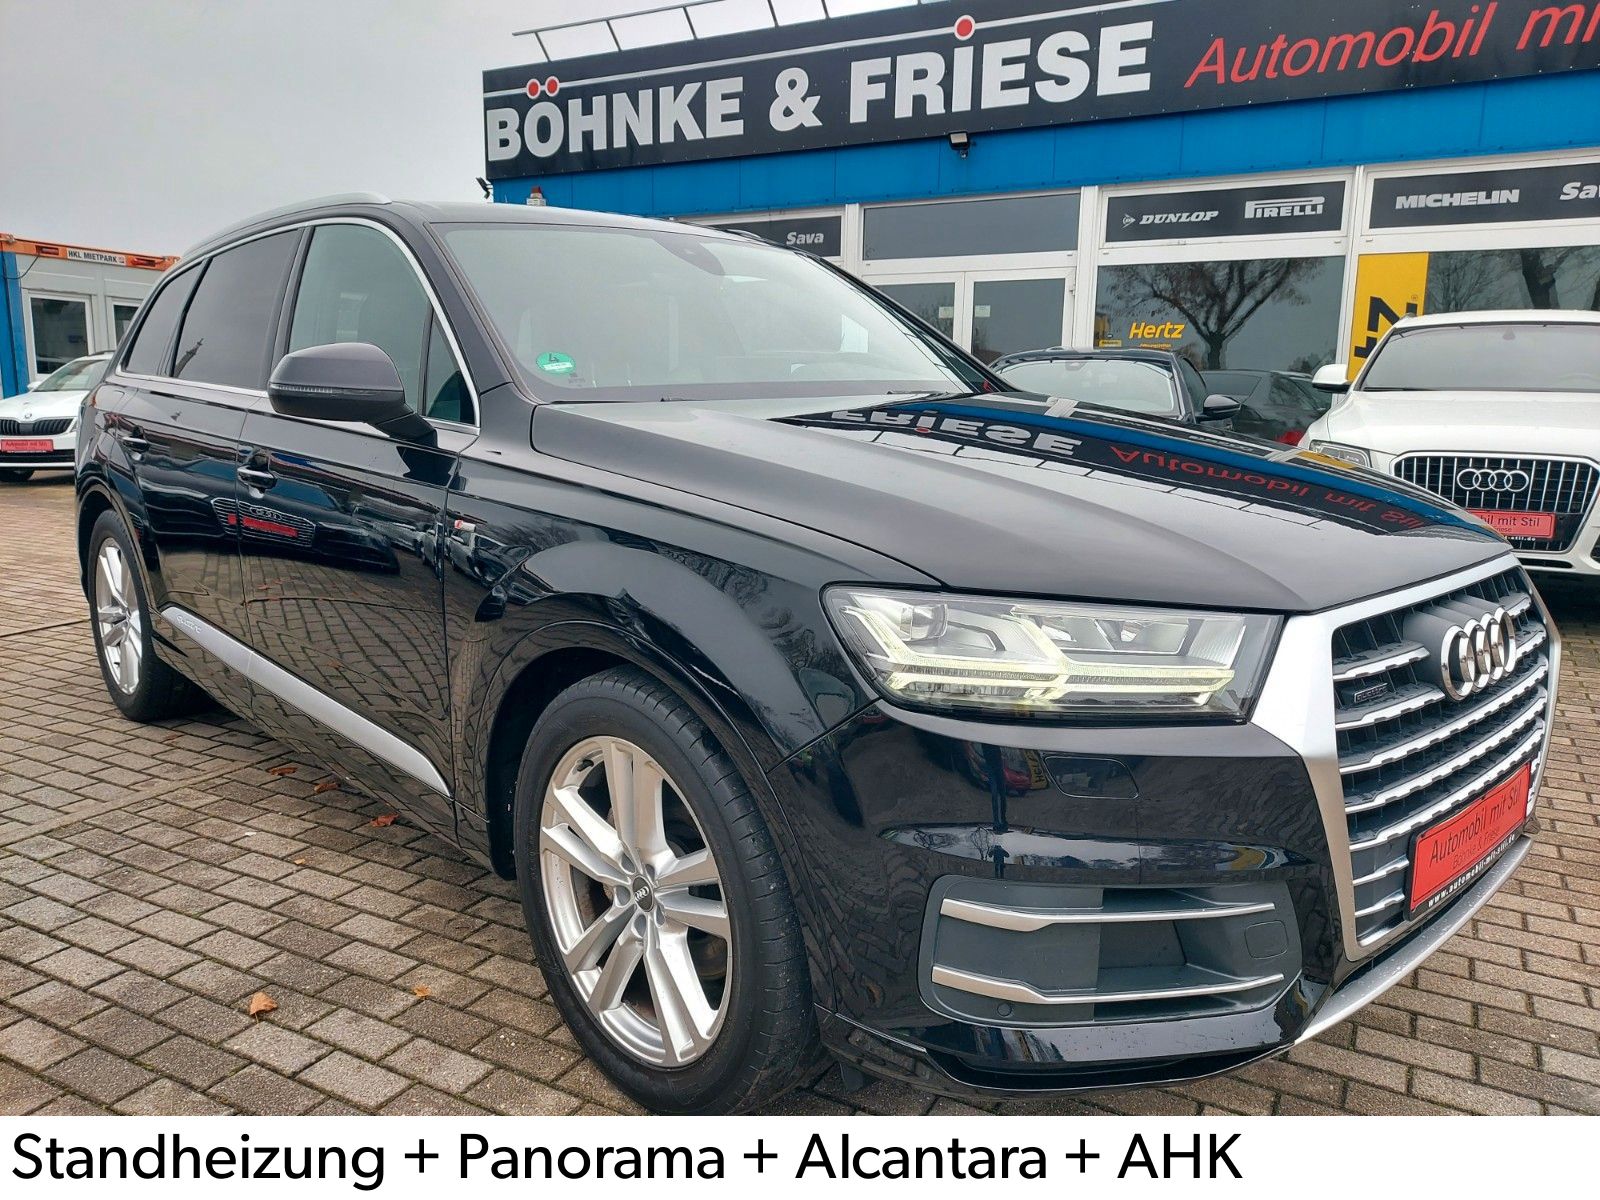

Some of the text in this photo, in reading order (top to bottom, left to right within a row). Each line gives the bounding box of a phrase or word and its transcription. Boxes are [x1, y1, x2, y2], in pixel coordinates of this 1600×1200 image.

[486, 76, 744, 162] BÖHNKE
[769, 67, 823, 132] &
[850, 15, 1153, 124] FRIESE
[1184, 2, 1498, 88] Automobil
[1395, 188, 1520, 209] MICHELIN
[1560, 182, 1600, 200] Sa
[1244, 196, 1326, 219] PIRELLI
[1139, 211, 1219, 225] DUNLOP
[786, 230, 825, 246] Sava
[68, 250, 118, 263] HKL MIETPARK
[1128, 321, 1185, 339] Hertz
[1497, 515, 1518, 526] mit
[1521, 515, 1540, 527] Stil
[1429, 806, 1488, 869] Automobil
[1490, 795, 1507, 822] mit
